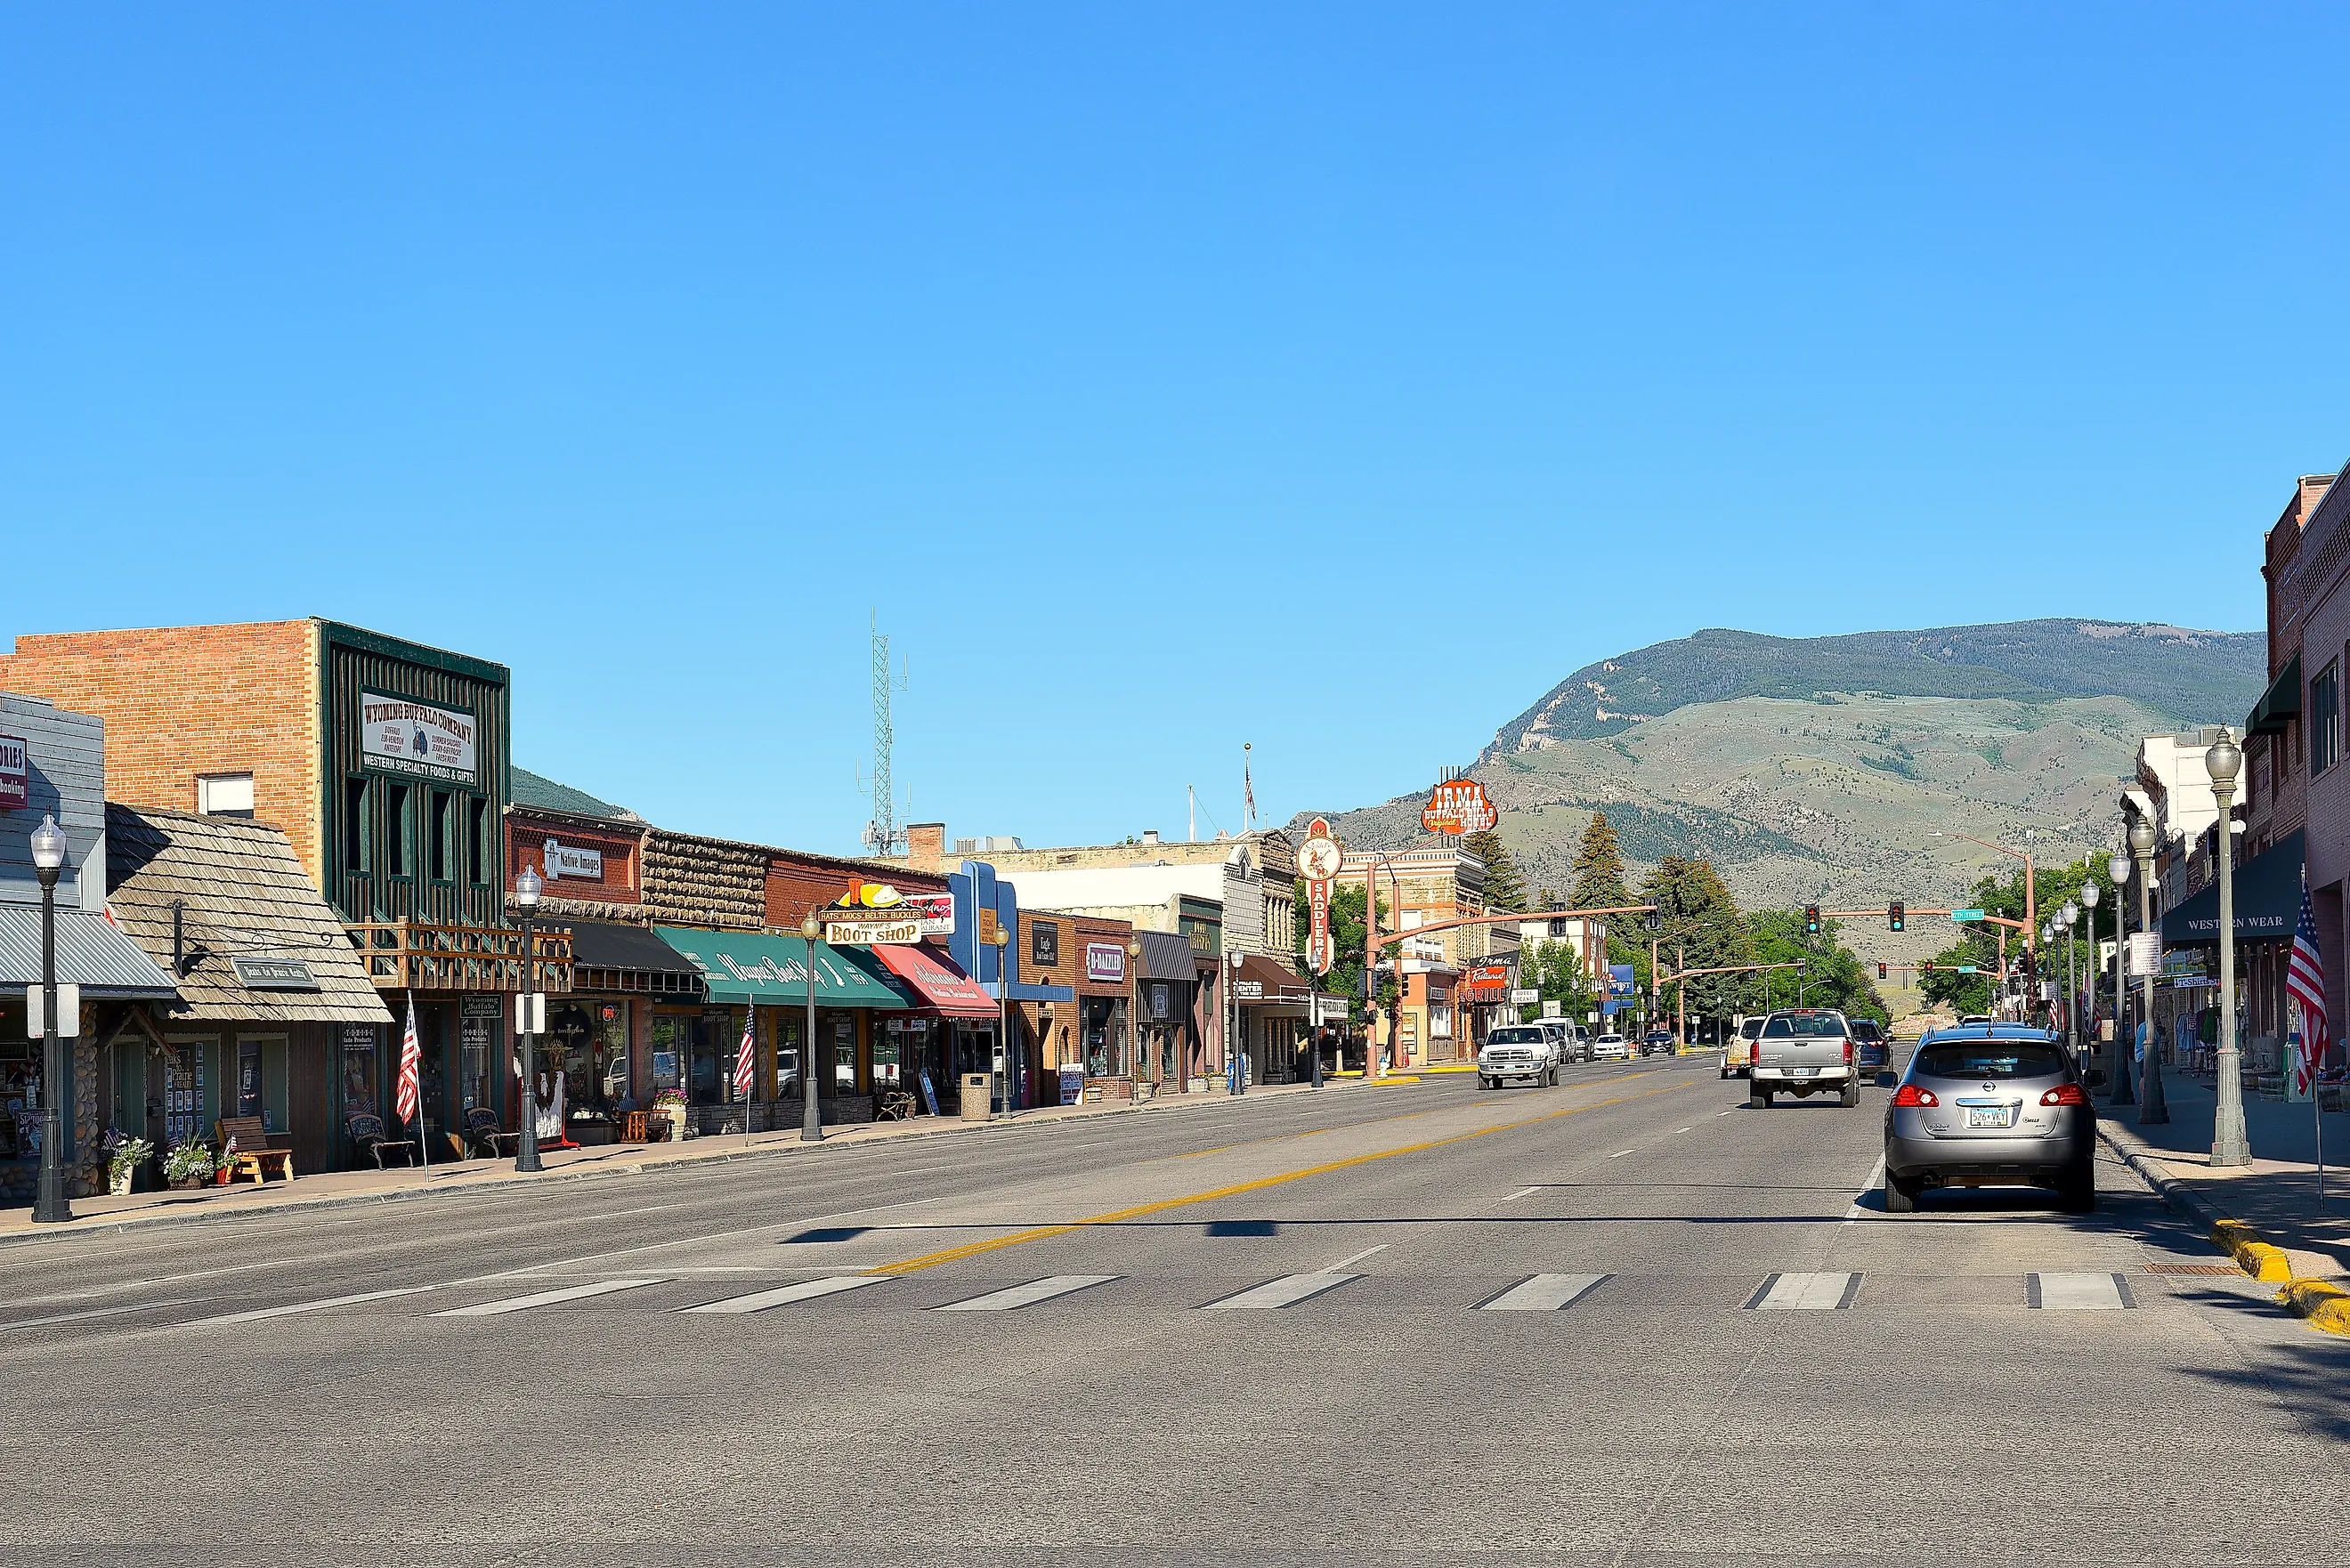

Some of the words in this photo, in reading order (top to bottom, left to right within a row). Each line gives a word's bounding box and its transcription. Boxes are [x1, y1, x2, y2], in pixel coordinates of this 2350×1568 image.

[365, 703, 402, 724] WYOMING
[404, 703, 437, 726] BUFFALO
[438, 712, 472, 745] COMPANY
[364, 753, 394, 769] WESTERN
[396, 759, 429, 775] SPECIALTY
[430, 766, 450, 779] FOODS
[450, 770, 456, 780] &
[457, 772, 474, 783] GIFTS
[1436, 787, 1484, 809] IRMA
[1425, 808, 1464, 819] BUFFALO
[1428, 819, 1456, 828] Original
[1461, 817, 1492, 828] HOTEL
[560, 851, 579, 869] Native
[579, 853, 599, 874] Images
[821, 911, 839, 920] HATS
[842, 911, 862, 920] MOCS
[864, 911, 887, 919] BELTS
[890, 910, 921, 919] BUCKLES
[1314, 883, 1325, 956] SADDLERY
[857, 922, 891, 930] WAYNE'S
[2188, 917, 2244, 930] WESTRN
[2249, 917, 2283, 927] WEAR
[831, 924, 872, 942] BOOT
[876, 925, 917, 942] SHOP
[1040, 937, 1051, 952] Eagle
[1477, 957, 1513, 967] Irma
[1471, 967, 1506, 983] Restaurant
[465, 997, 498, 1005] Wyoming
[1465, 987, 1504, 1002] GRILL
[464, 1008, 498, 1016] Company
[172, 1069, 193, 1080] Prairie
[1973, 1112, 1987, 1121] 526
